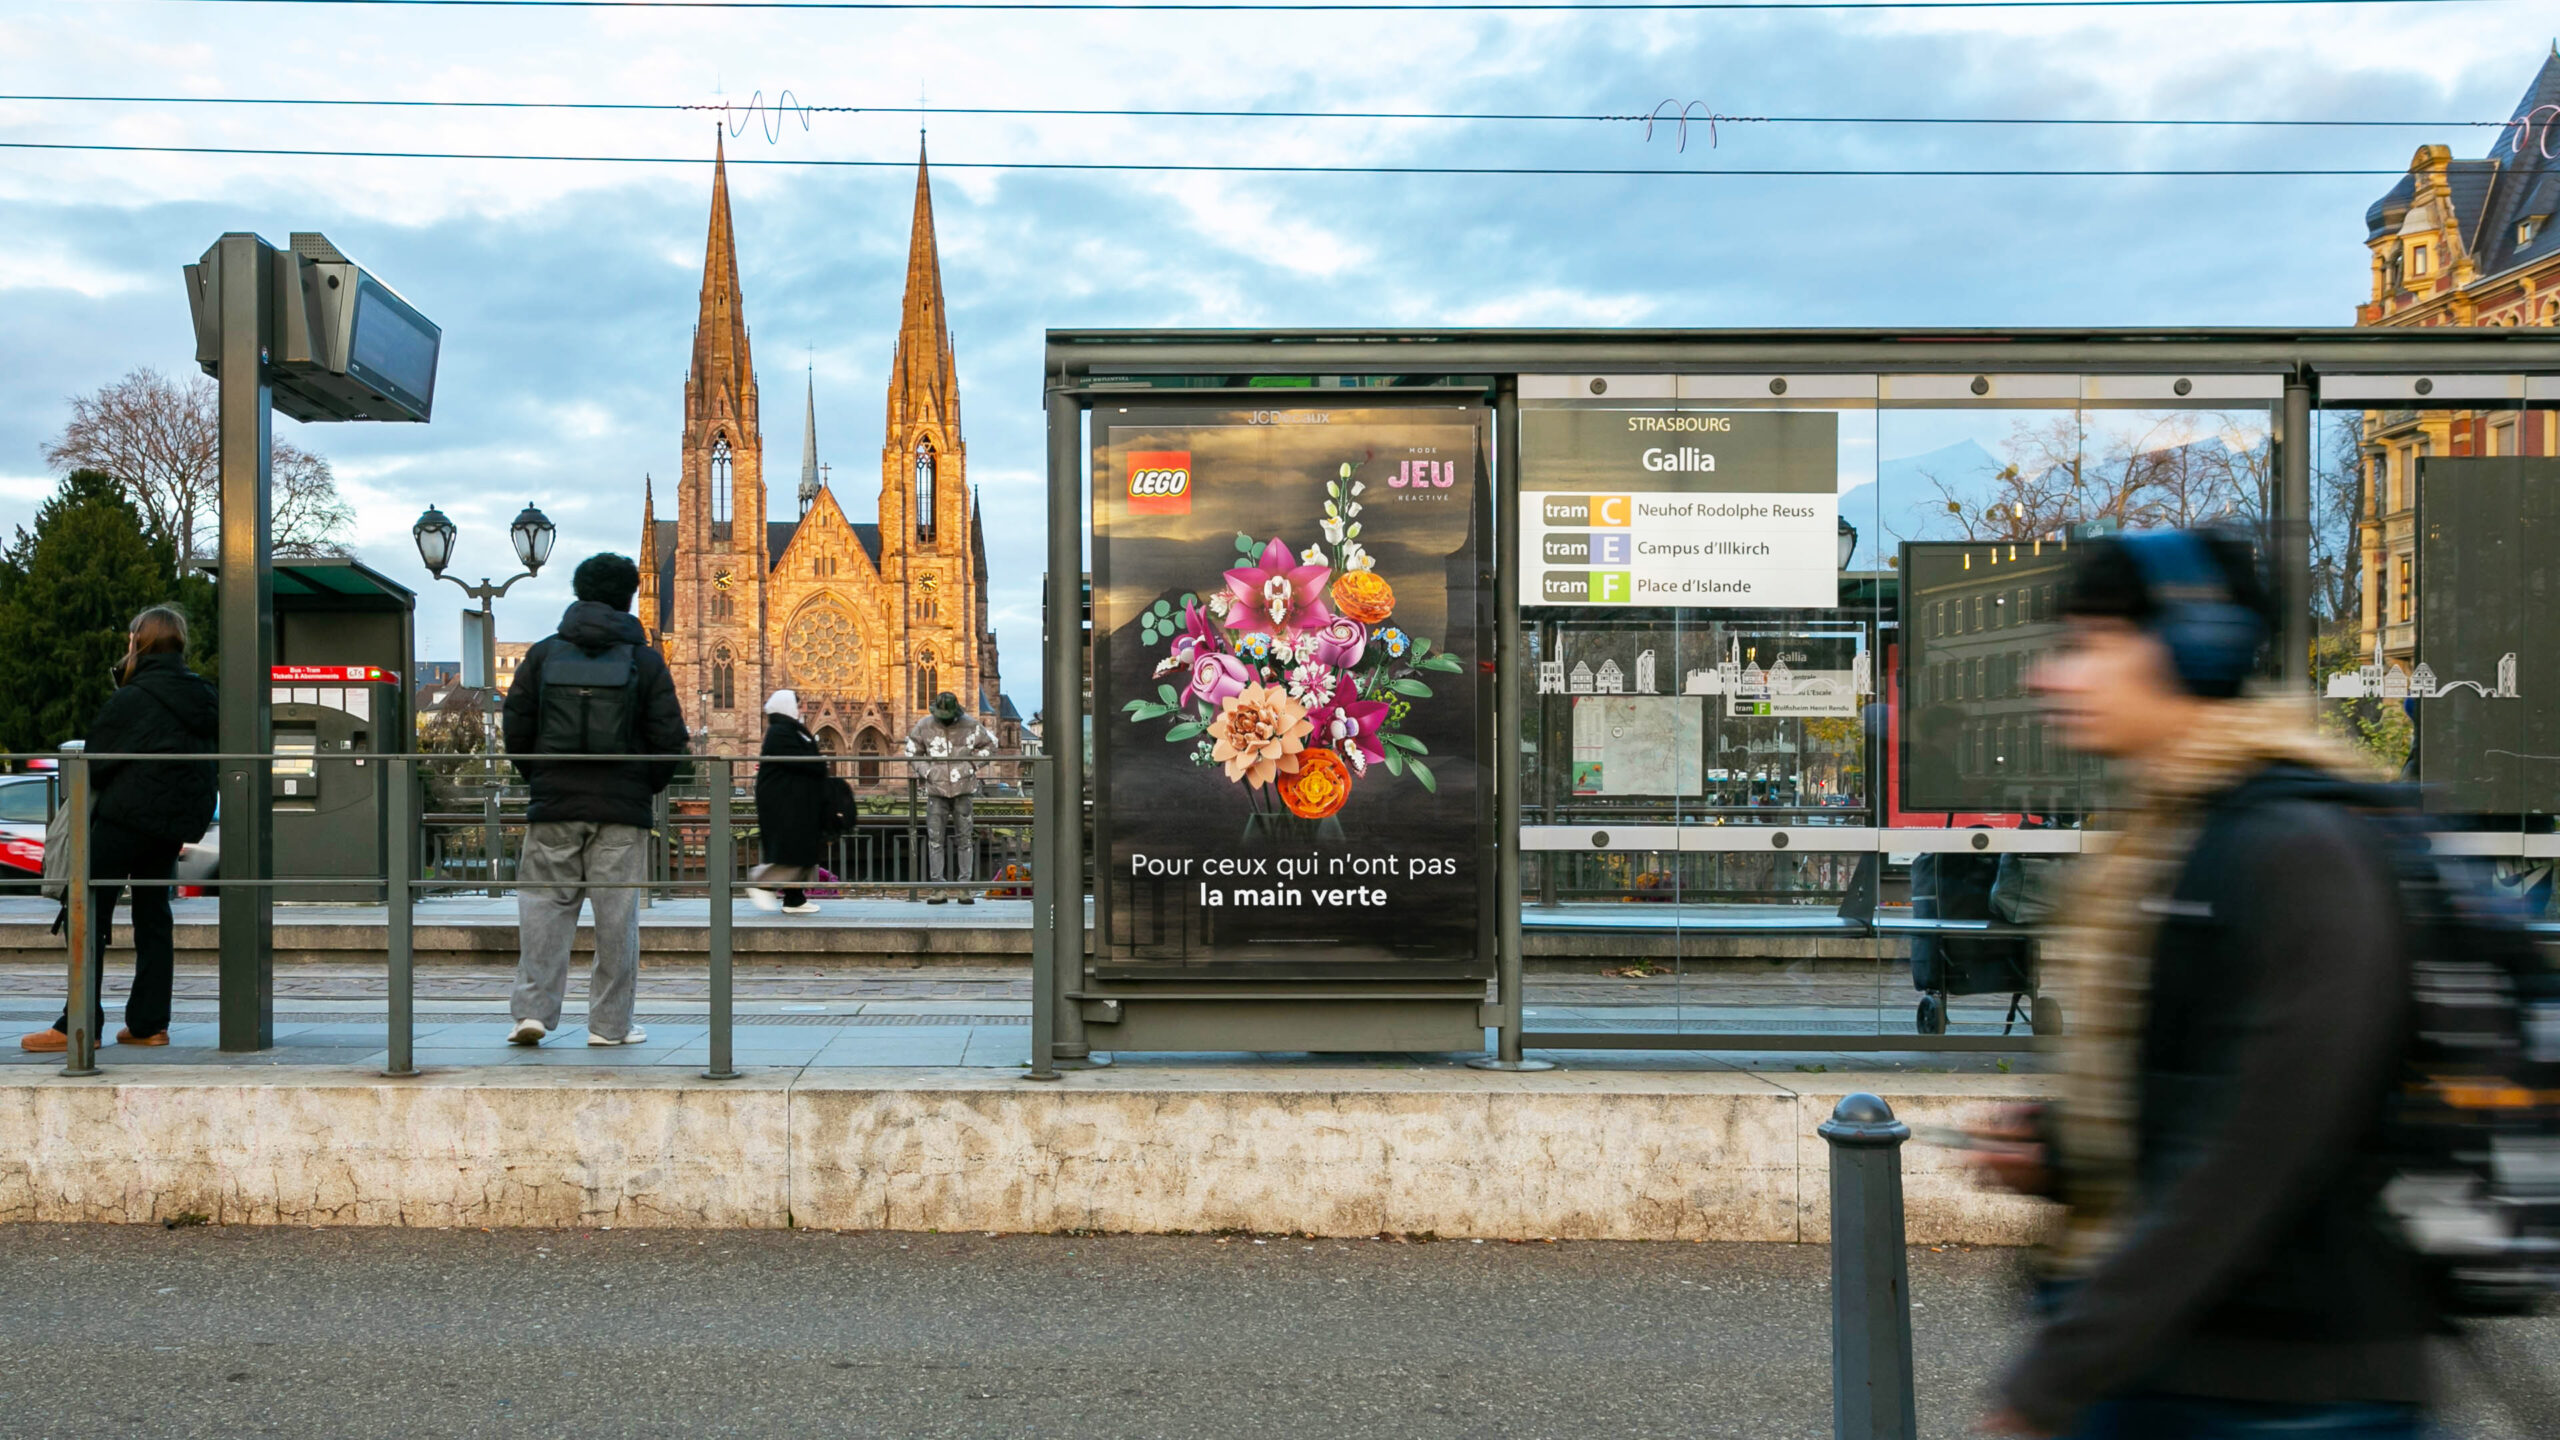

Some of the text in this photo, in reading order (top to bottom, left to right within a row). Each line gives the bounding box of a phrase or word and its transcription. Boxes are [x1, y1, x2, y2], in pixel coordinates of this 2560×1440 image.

[1248, 410, 1331, 425] JCDecaux
[1628, 417, 1731, 431] STRASBOURG
[1642, 447, 1716, 472] Gallia
[1130, 469, 1189, 496] LEGO
[1388, 460, 1454, 488] JEU
[1545, 498, 1815, 524] tram C Neuhof Rodolphe Reuss
[1545, 541, 1588, 556] tram
[1603, 536, 1620, 562] E
[1638, 541, 1700, 557] Campus
[1545, 579, 1588, 593] tram
[1603, 574, 1620, 600] F
[1638, 578, 1678, 592] Place
[1776, 651, 1808, 663] Gallia
[1735, 704, 1754, 712] tram
[1759, 703, 1767, 714] F
[1132, 851, 1457, 881] Pour ceux qui n'ont pas
[1200, 881, 1388, 907] la main verte
